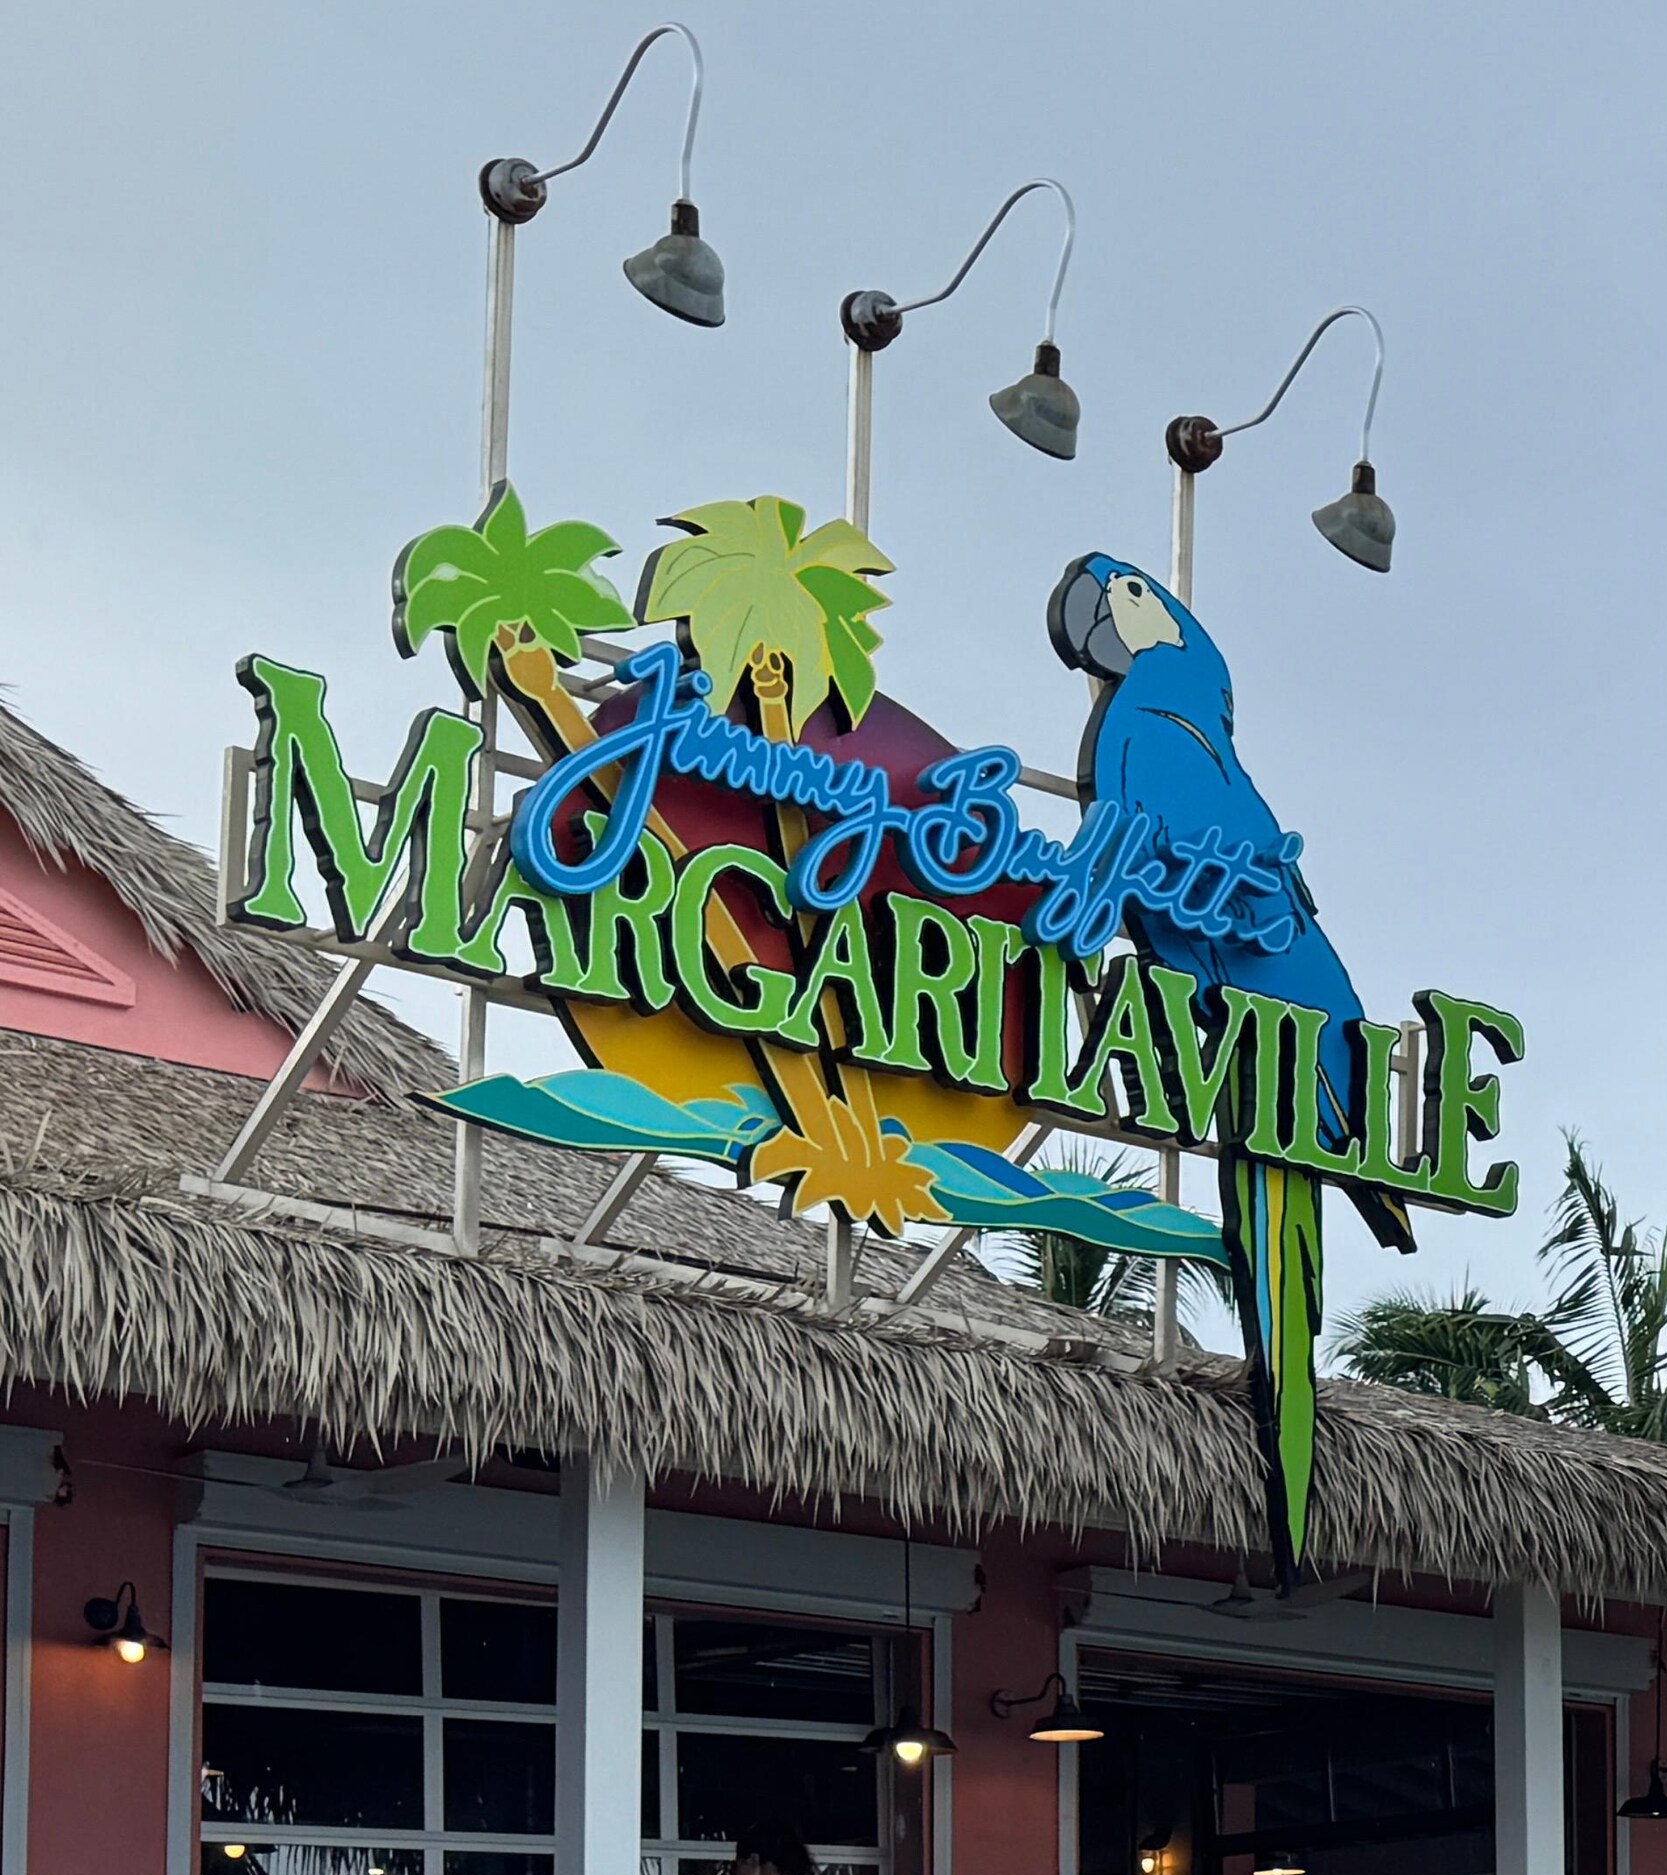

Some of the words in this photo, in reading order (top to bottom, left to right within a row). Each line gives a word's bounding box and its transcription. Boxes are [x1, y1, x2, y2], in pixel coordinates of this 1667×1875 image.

[228, 651, 1526, 1216] MARGARITAVILLE
[512, 641, 905, 913] Jimmy
[893, 745, 1306, 963] Buffett's
